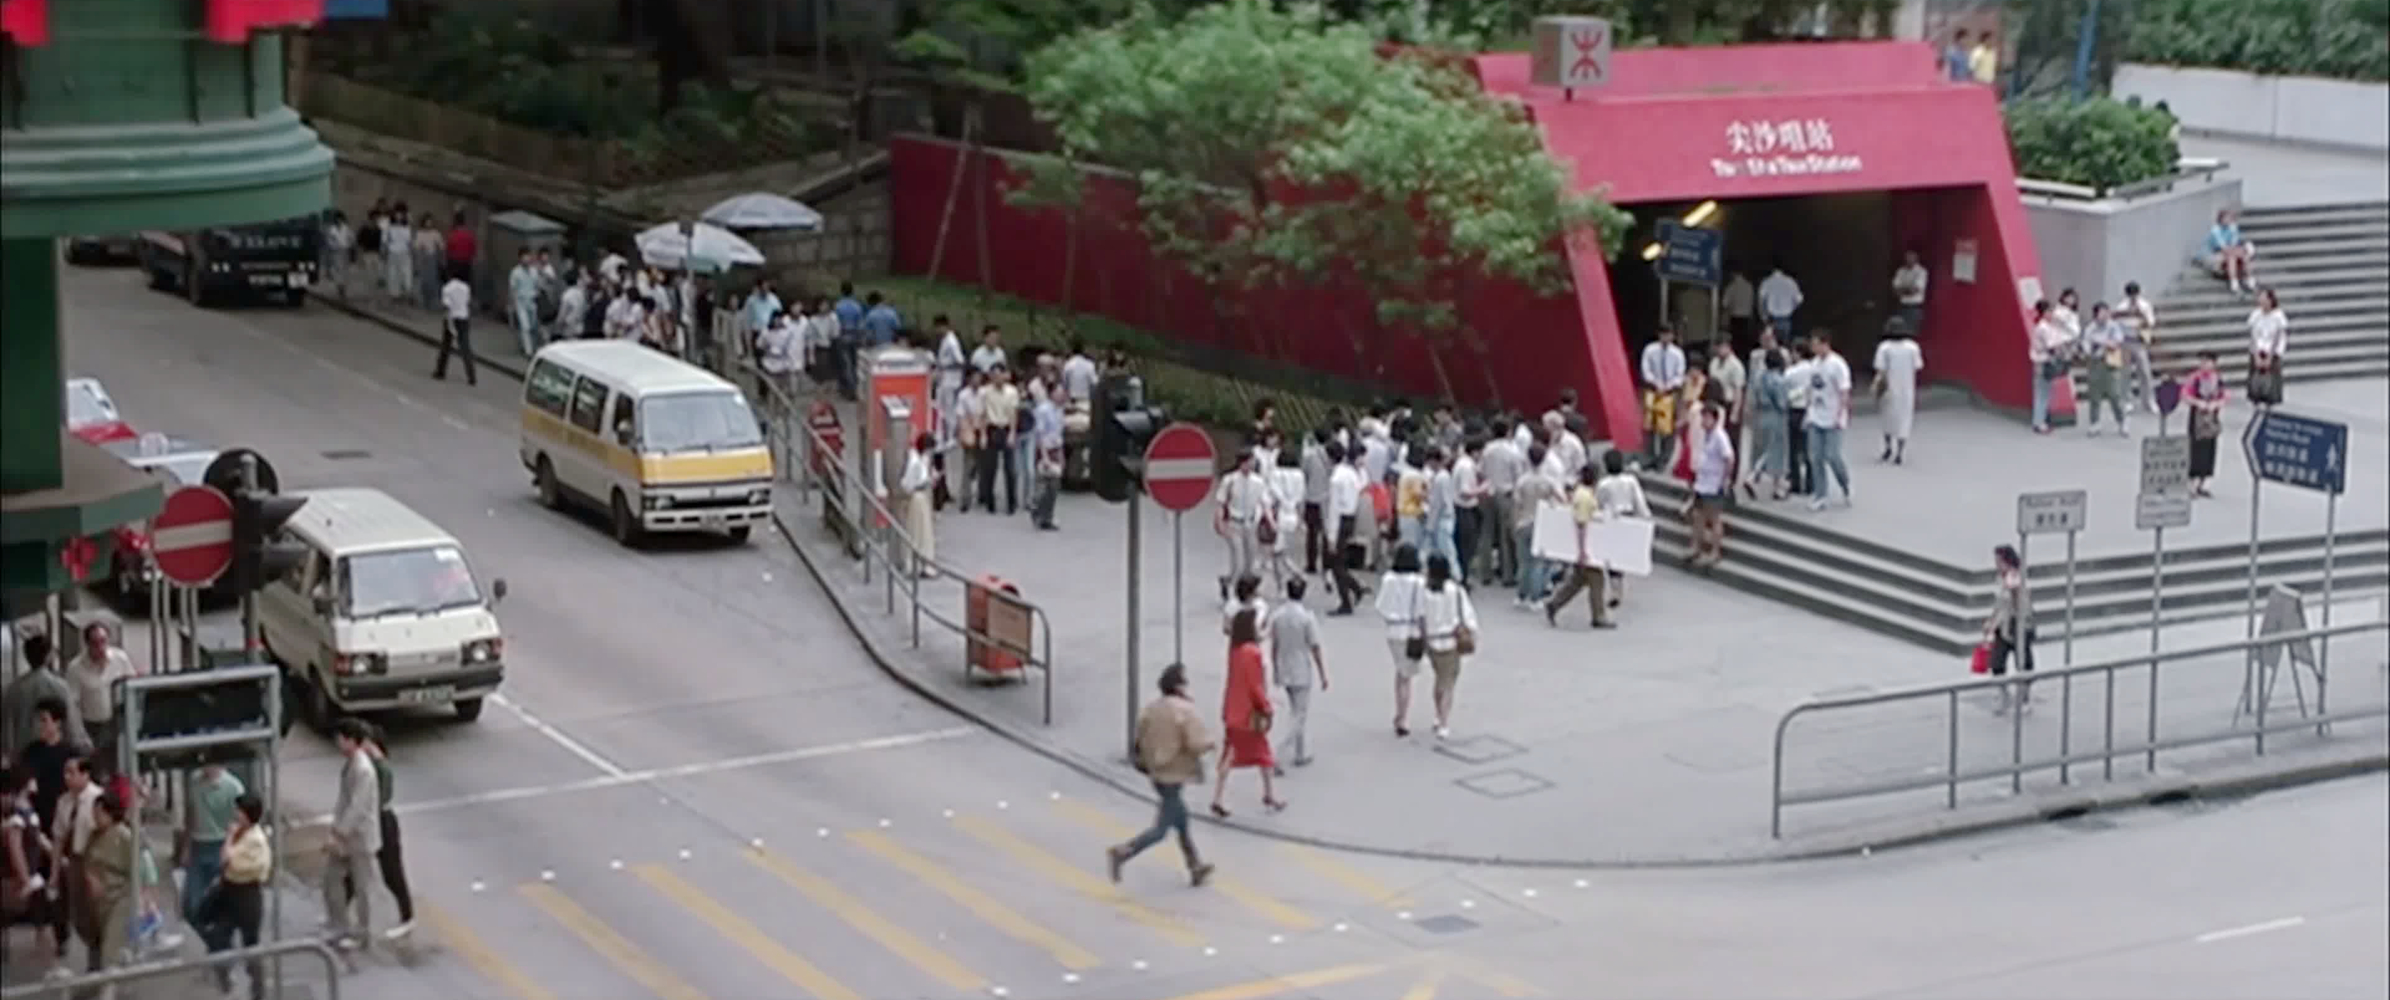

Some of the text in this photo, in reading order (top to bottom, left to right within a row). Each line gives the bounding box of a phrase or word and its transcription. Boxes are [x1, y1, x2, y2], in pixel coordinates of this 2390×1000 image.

[1726, 118, 1834, 153] 尖沙咀站
[1806, 154, 1862, 173] Station
